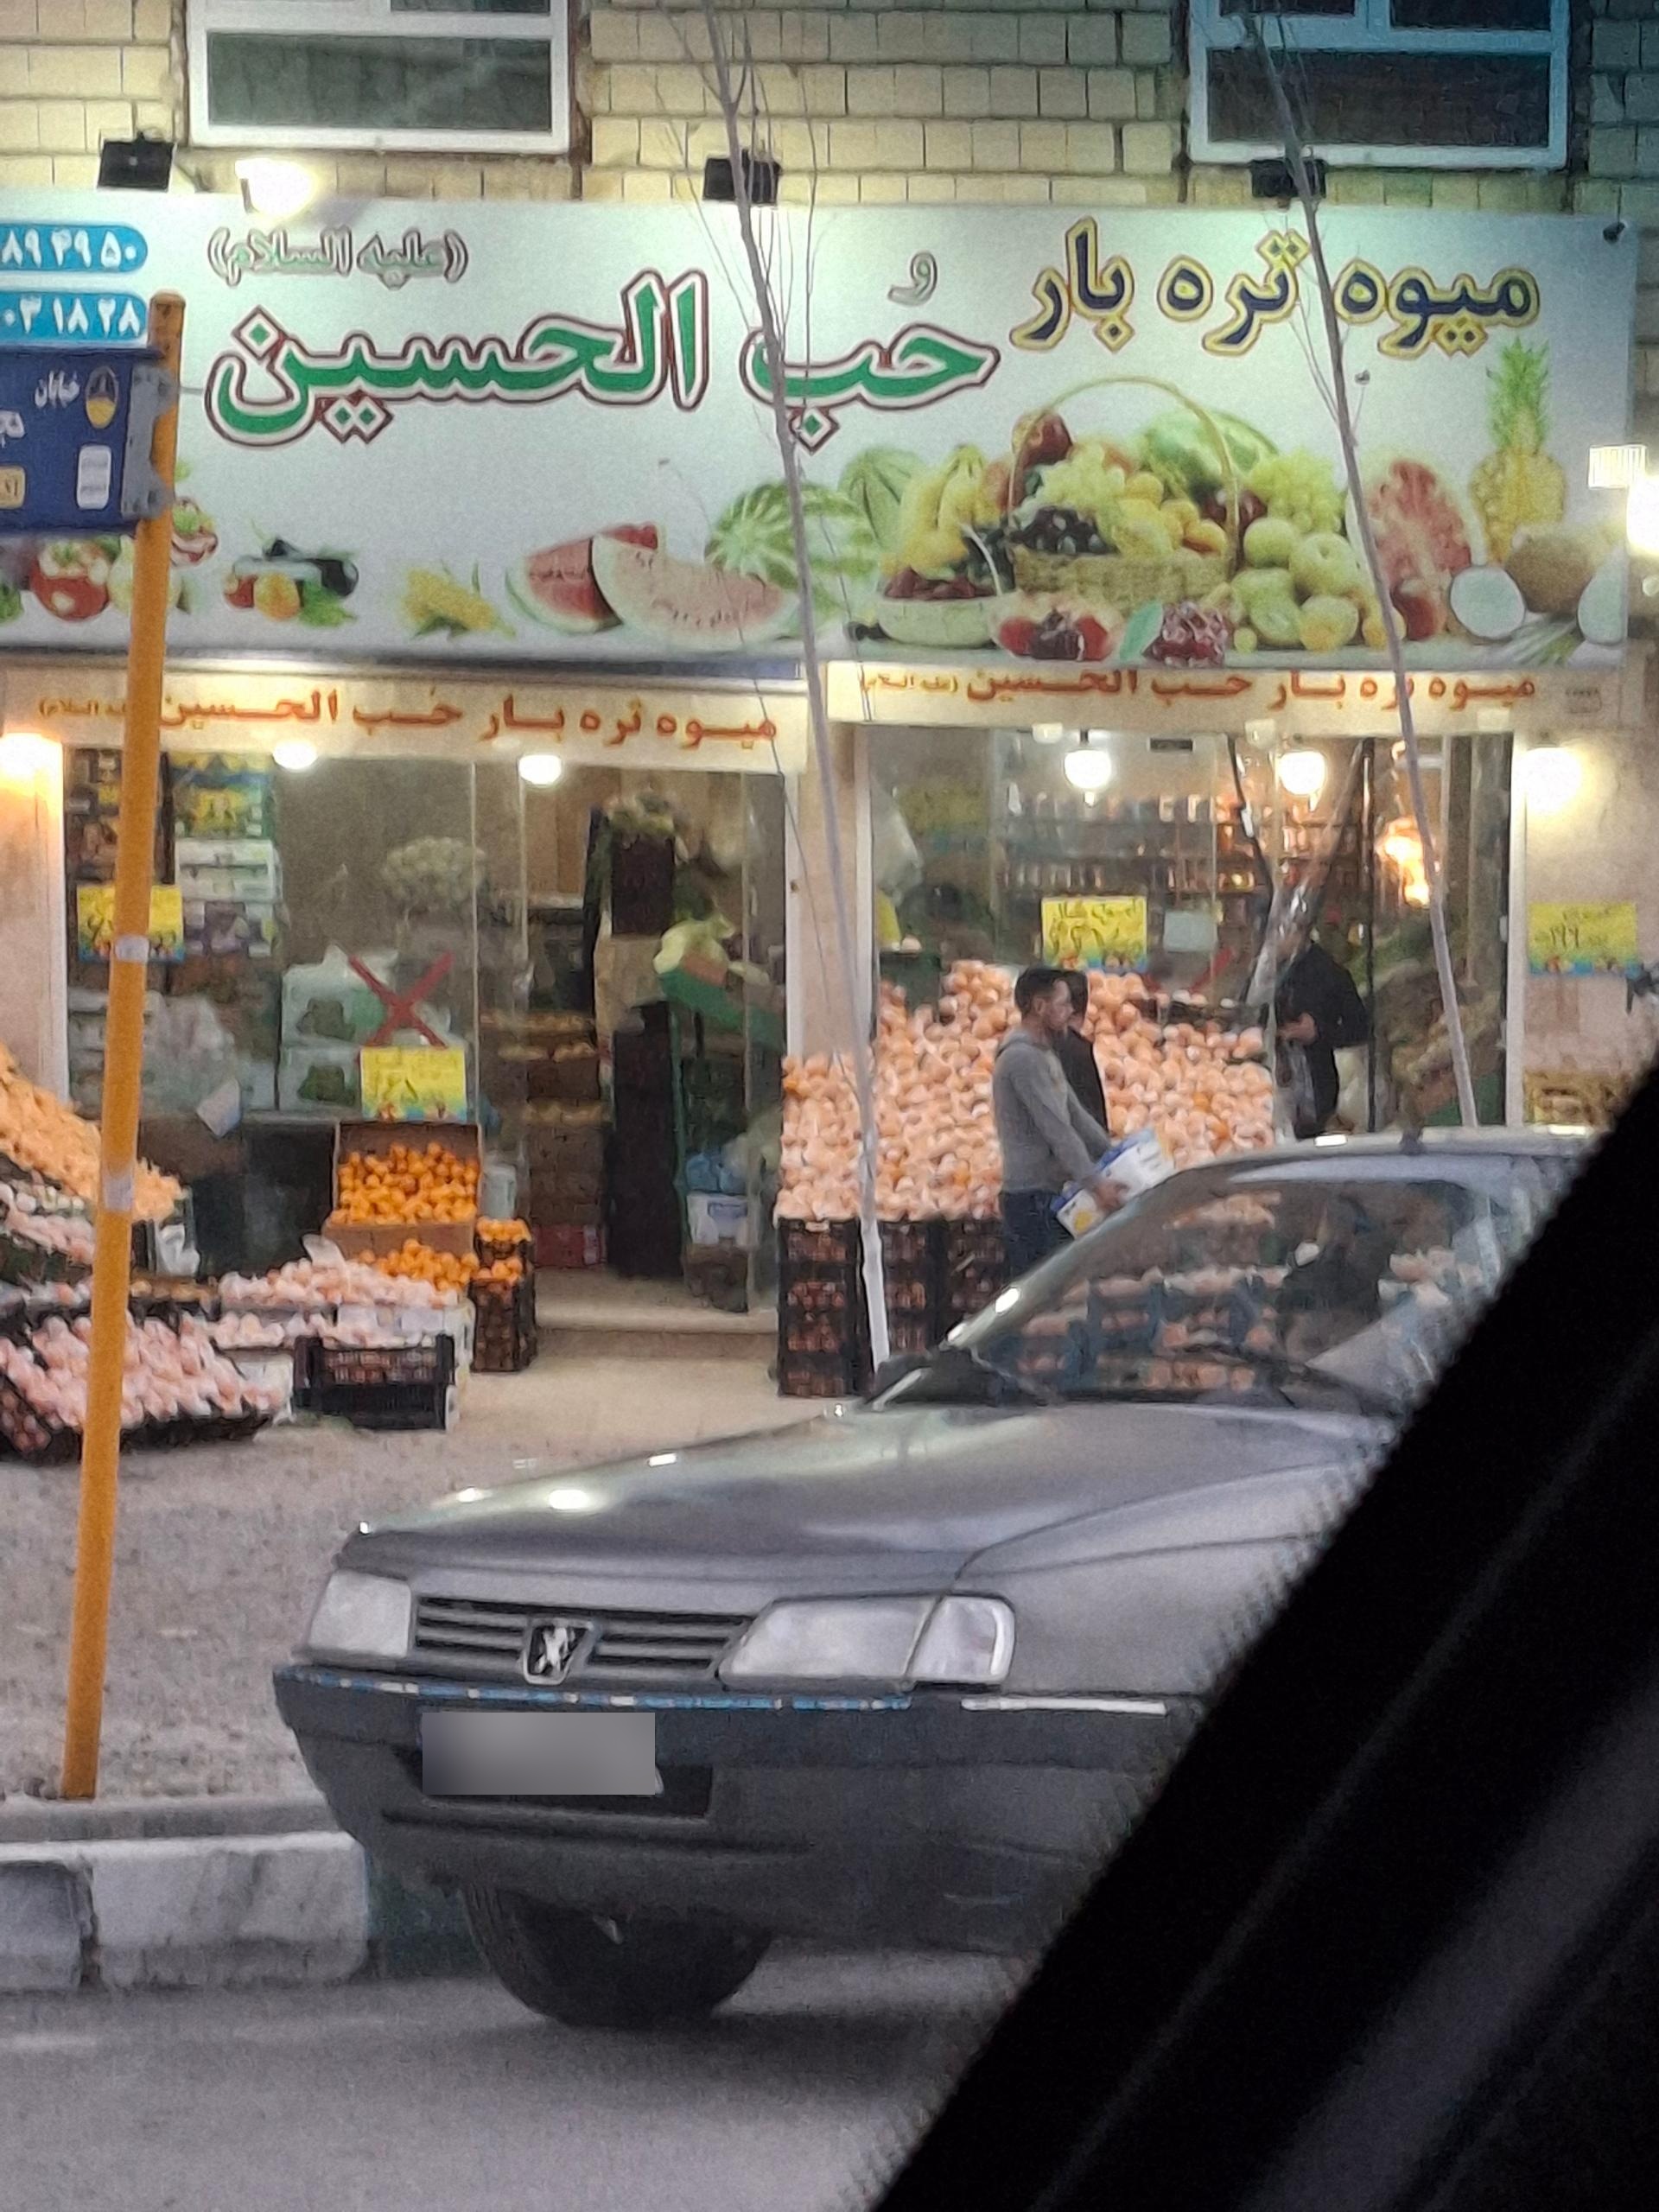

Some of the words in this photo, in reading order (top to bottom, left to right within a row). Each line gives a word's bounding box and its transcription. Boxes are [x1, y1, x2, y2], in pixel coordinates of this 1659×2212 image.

[1010, 216, 1136, 352] بار
[1156, 228, 1309, 355] تره
[1333, 257, 1541, 357] میوه
[205, 268, 709, 448] الحسین
[477, 694, 564, 743] بار
